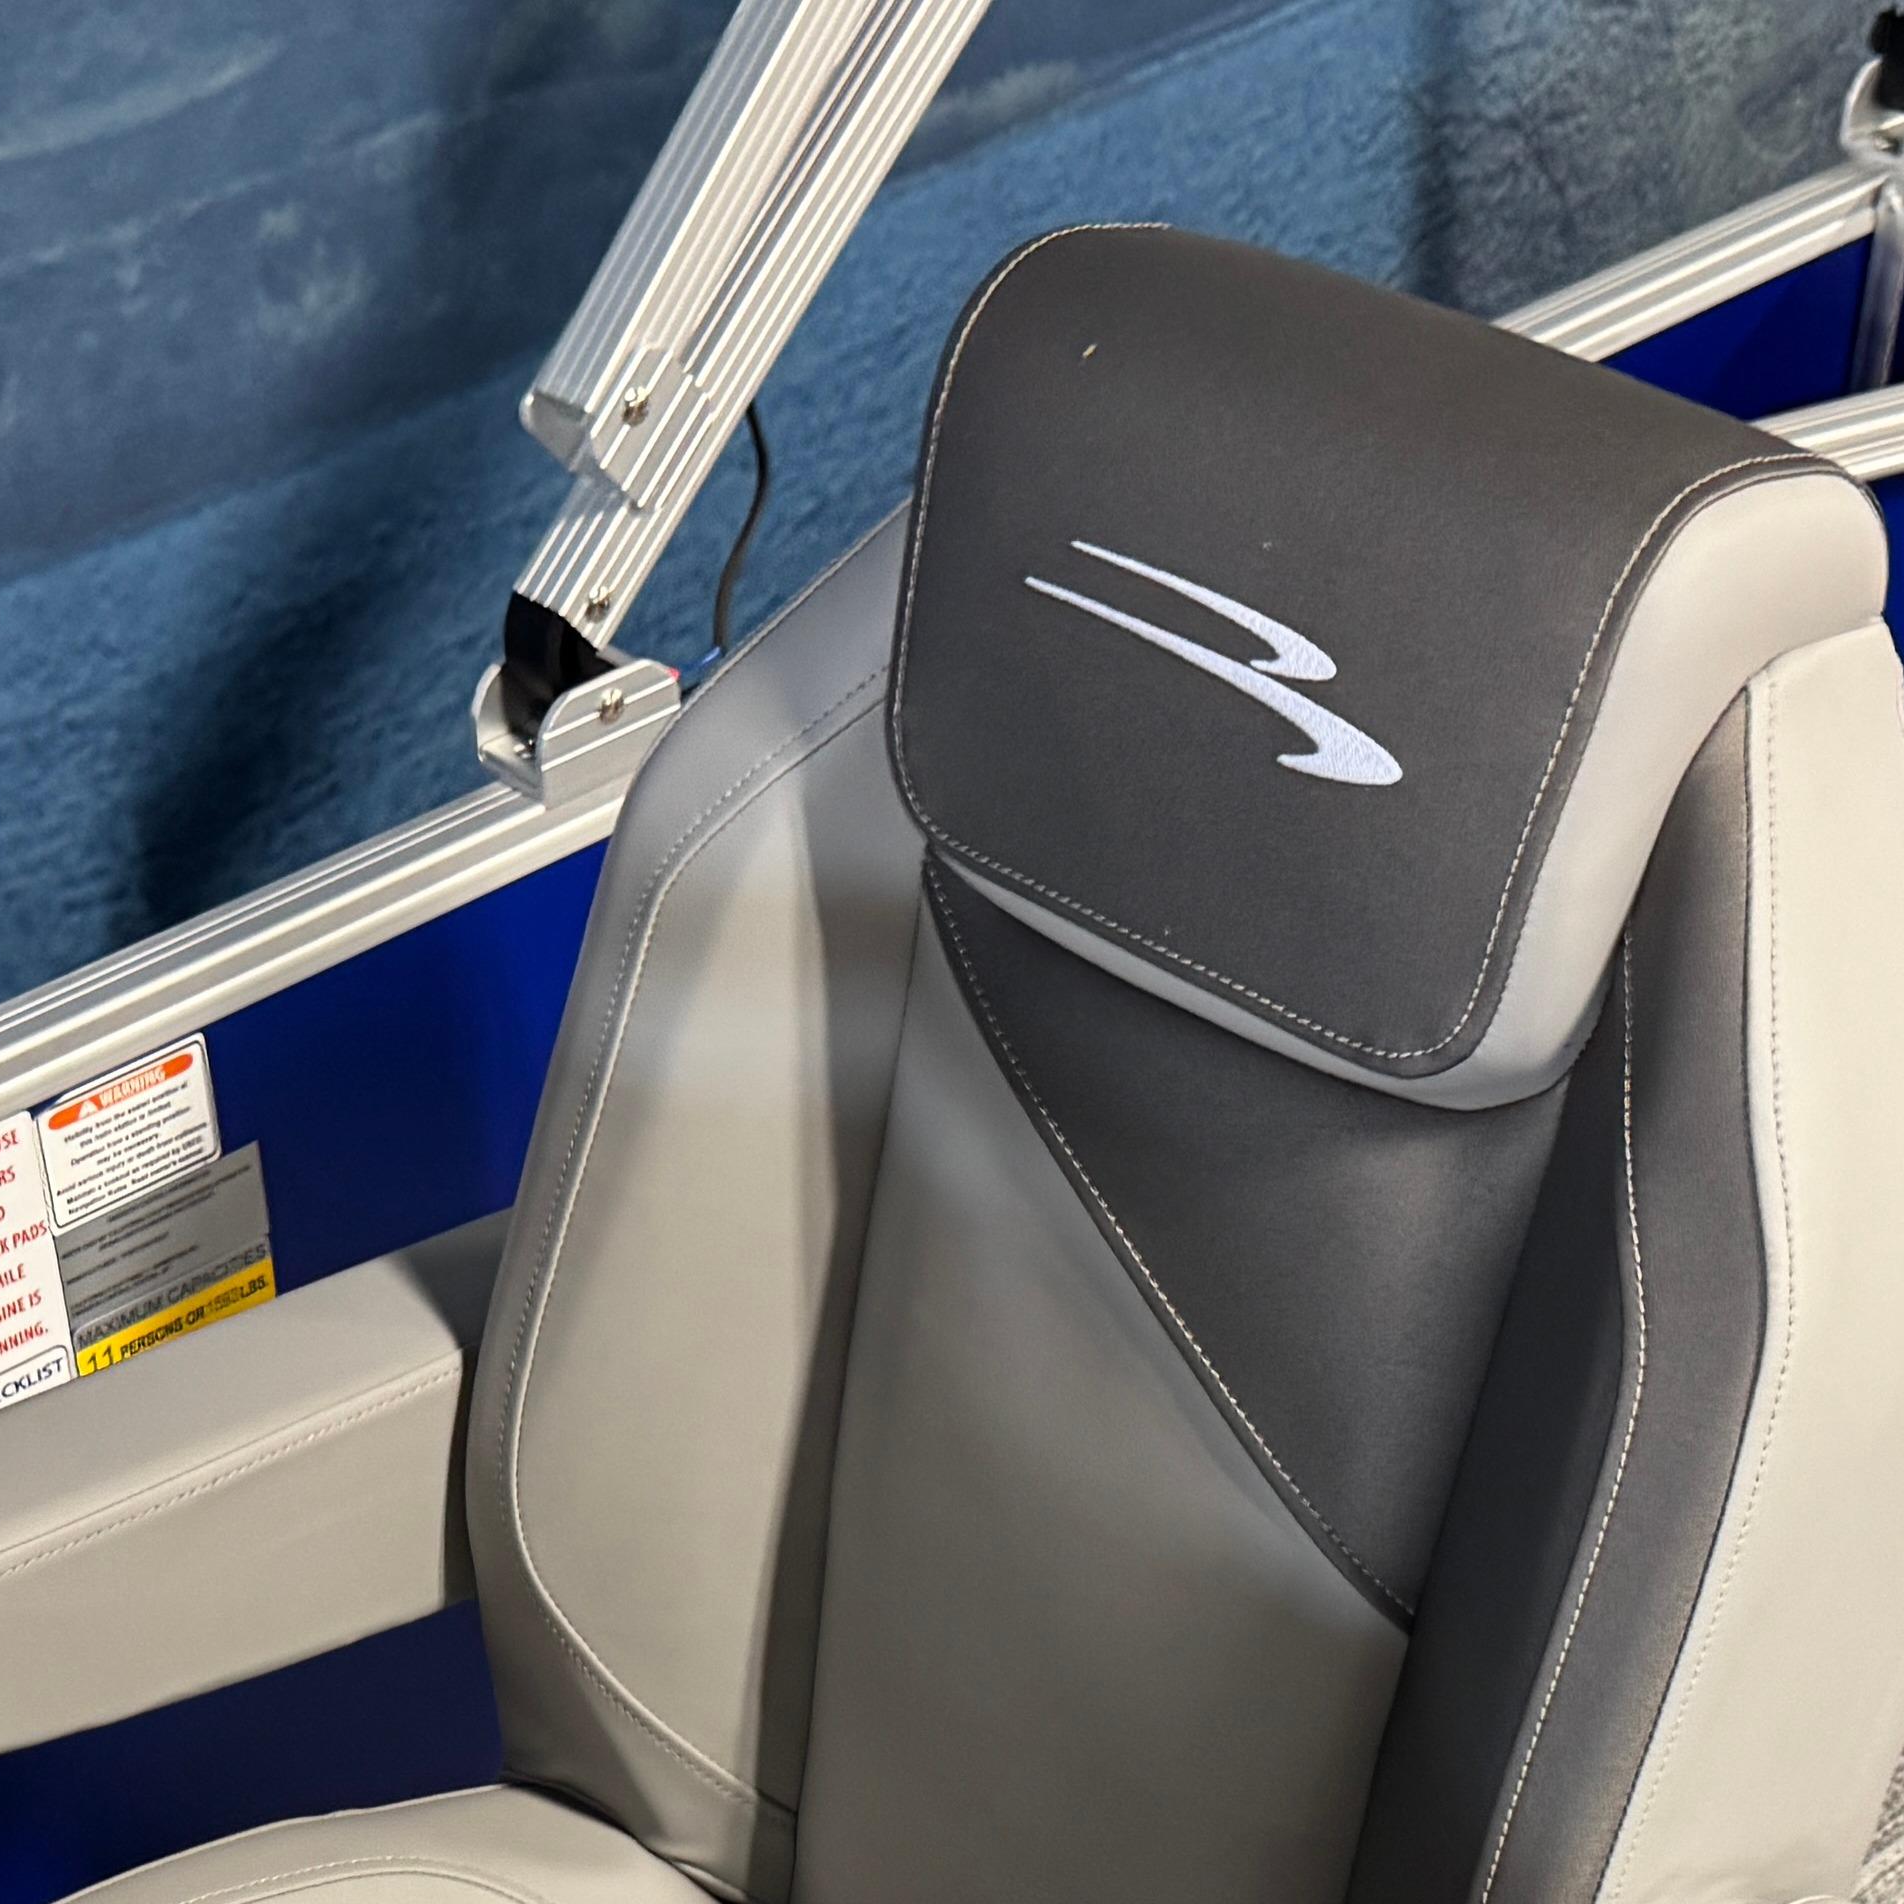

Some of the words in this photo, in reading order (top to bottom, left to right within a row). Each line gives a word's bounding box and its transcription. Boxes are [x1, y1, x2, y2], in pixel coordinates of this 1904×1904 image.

[99, 1065, 167, 1106] WARNING
[13, 1220, 47, 1248] PADS
[29, 1290, 41, 1307] IS
[77, 1296, 165, 1348] MAXIMUM
[87, 1344, 115, 1373] 11
[119, 1317, 183, 1360] PERSONS
[186, 1307, 205, 1326] OR
